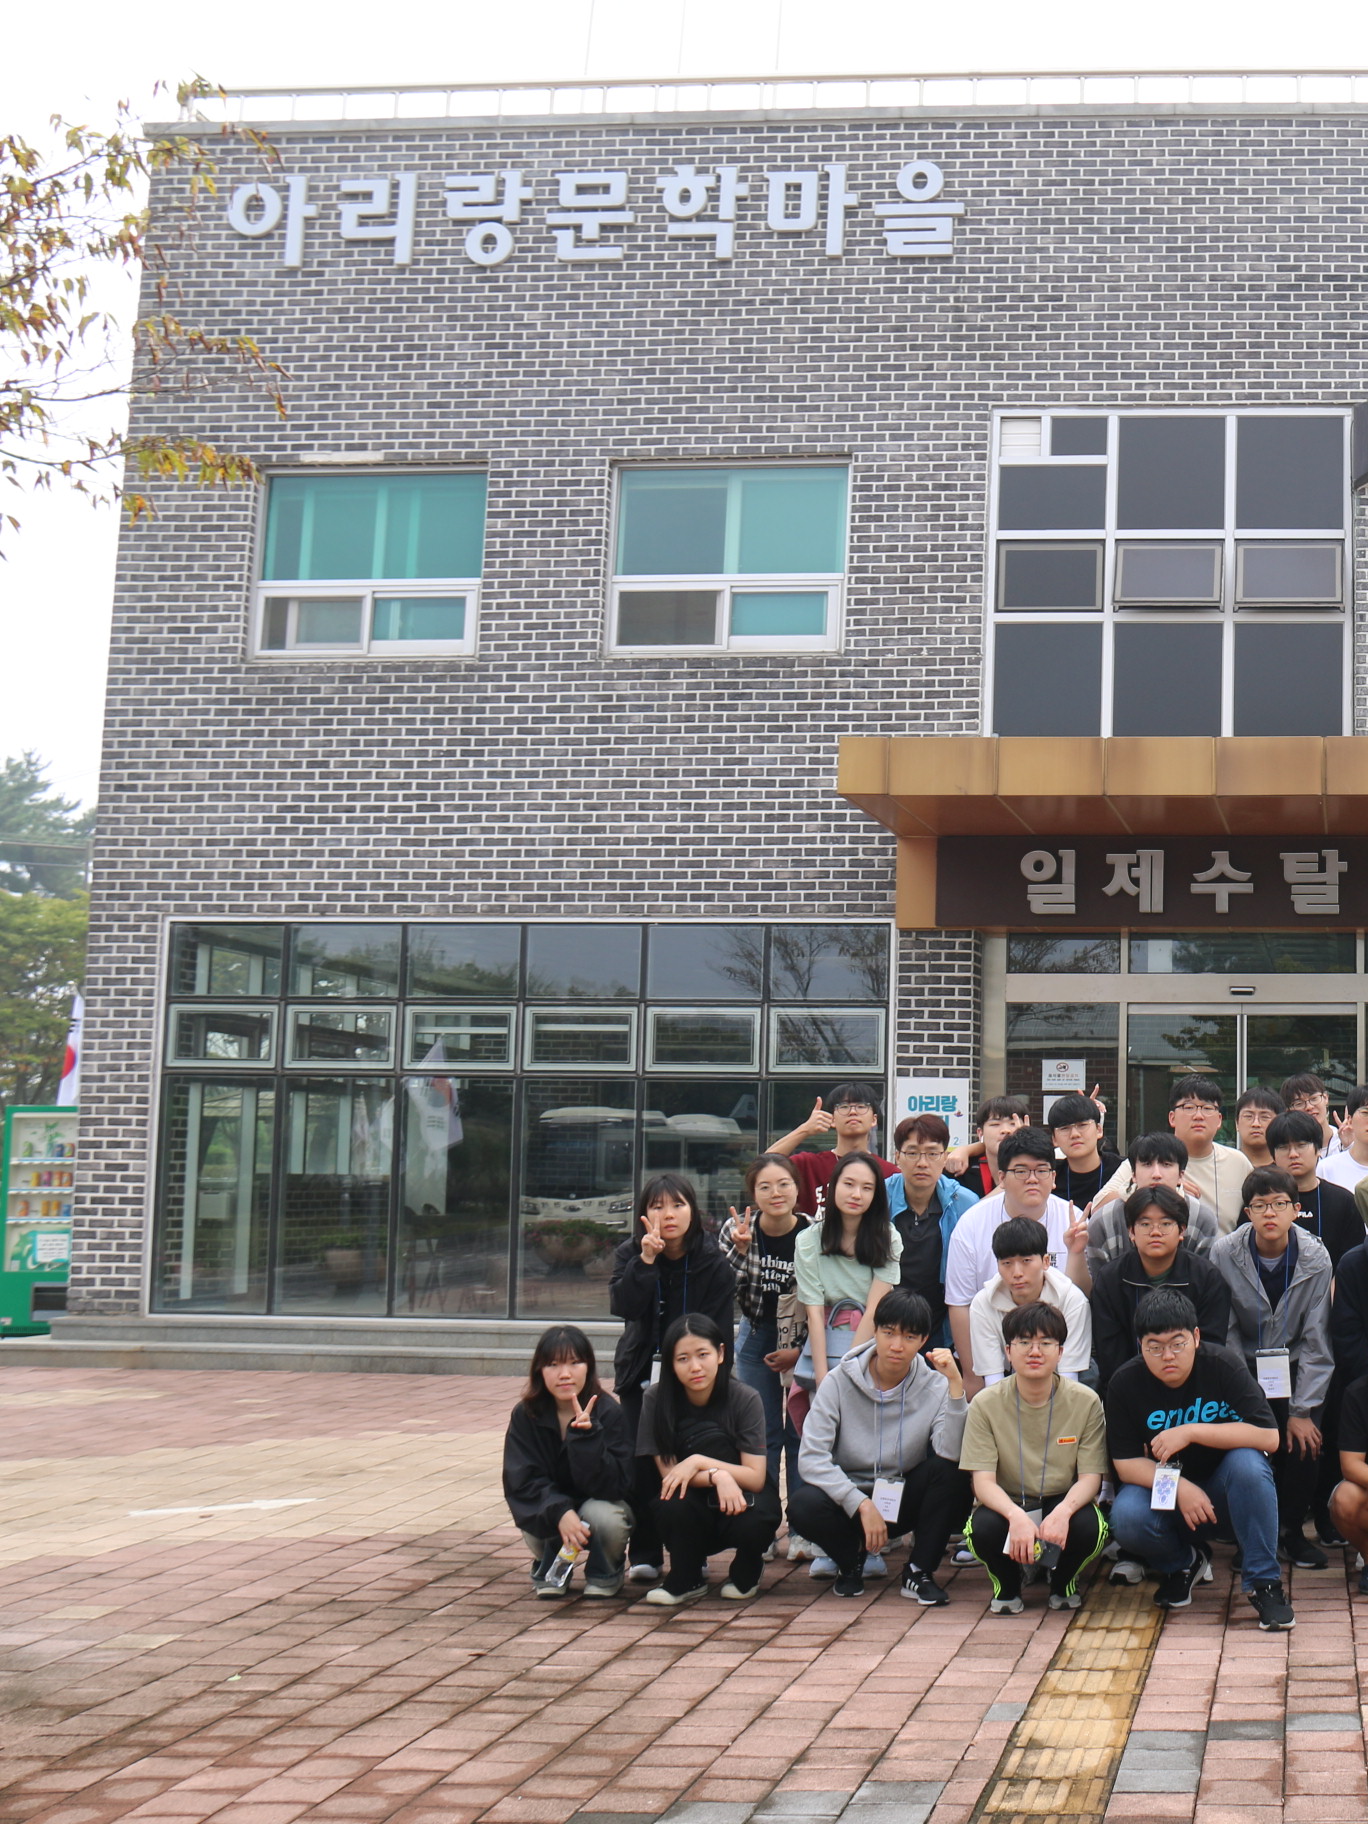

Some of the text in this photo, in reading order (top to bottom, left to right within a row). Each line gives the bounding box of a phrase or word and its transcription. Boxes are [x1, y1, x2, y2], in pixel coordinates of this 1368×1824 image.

[226, 159, 966, 268] 아리랑문학마을
[907, 1095, 958, 1112] 아리랑
[953, 1136, 960, 1145] 2
[759, 1254, 795, 1274] thing
[759, 1269, 789, 1283] etter
[760, 1280, 781, 1293] han
